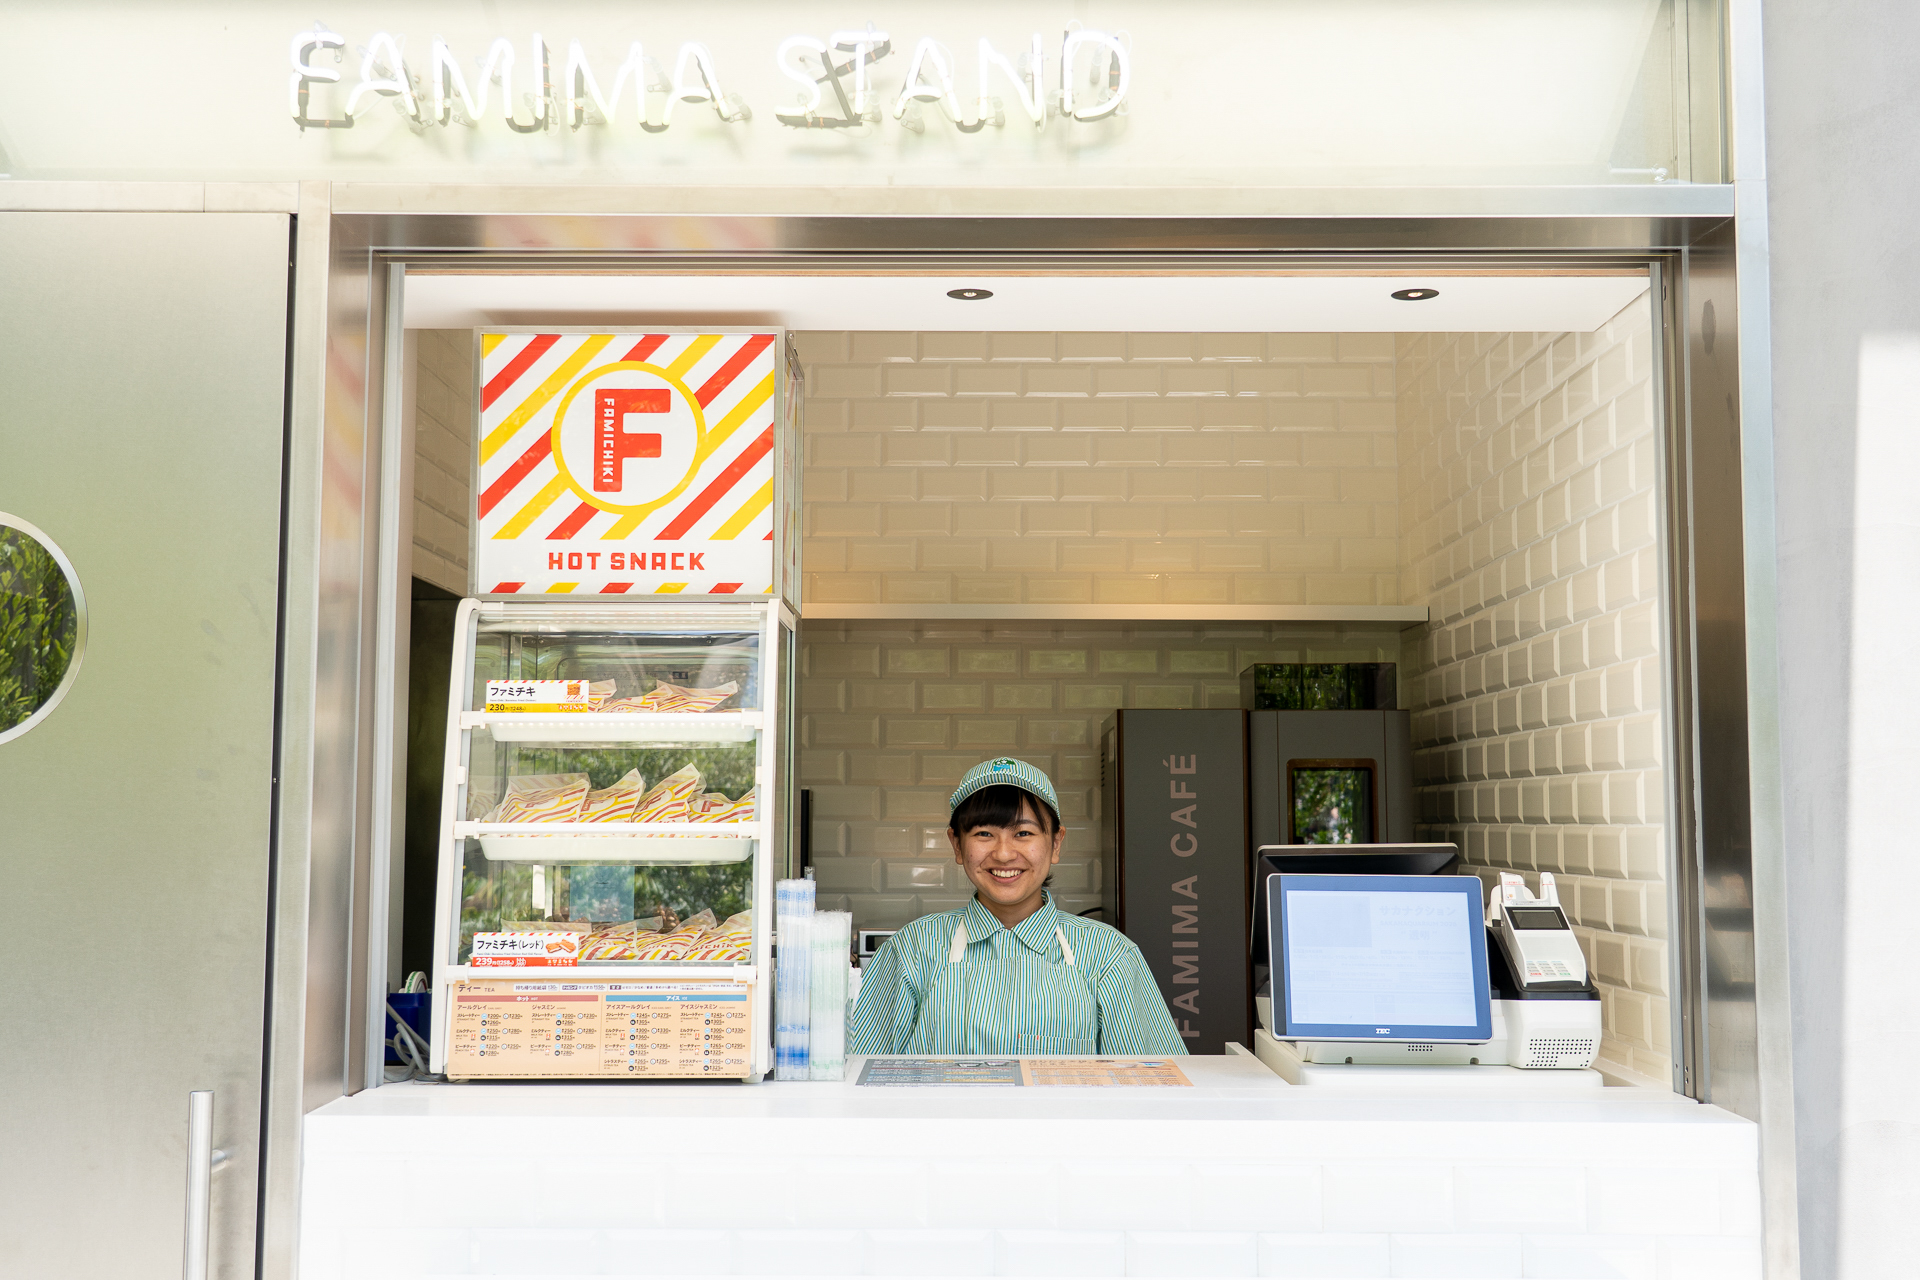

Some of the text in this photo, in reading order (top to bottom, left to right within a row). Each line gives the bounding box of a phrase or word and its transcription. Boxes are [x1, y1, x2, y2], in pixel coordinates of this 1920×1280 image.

[288, 30, 1131, 128] FAMIMA STAND
[594, 388, 671, 492] F
[602, 398, 615, 484] FAMICHIKI
[548, 552, 705, 571] HOT SNACK
[490, 686, 536, 697] ファミチキ
[1163, 753, 1200, 1038] FAMIMA CAFÉ
[1379, 905, 1456, 917] サカナクション
[458, 984, 481, 992] ティー
